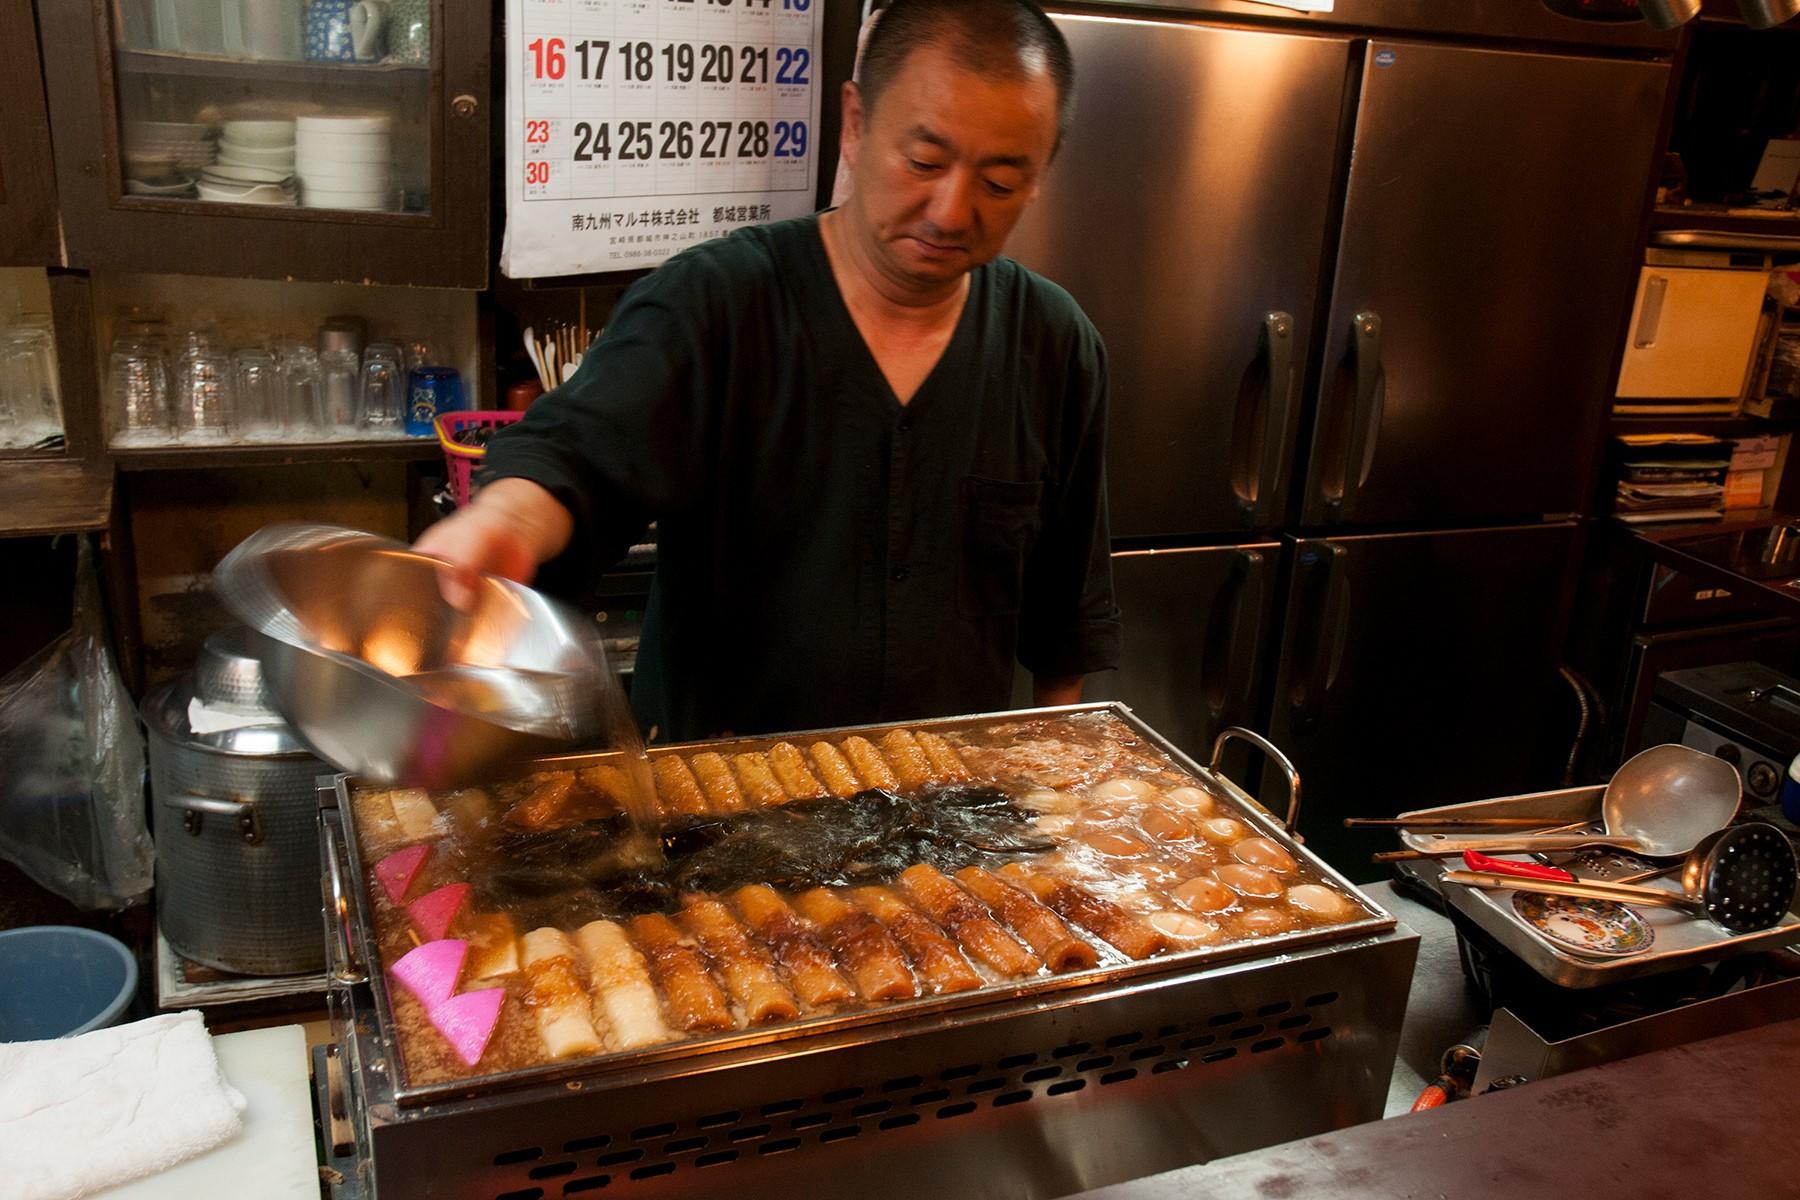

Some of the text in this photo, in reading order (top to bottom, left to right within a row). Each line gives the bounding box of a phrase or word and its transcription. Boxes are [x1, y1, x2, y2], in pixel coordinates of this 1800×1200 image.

[528, 37, 810, 85] 16 17 18 19 20 21 22
[526, 120, 808, 161] 23 24 25 26 27 28 29
[526, 161, 550, 185] 30
[571, 204, 771, 232] 南九州マルヰ株式会社 都城営業所
